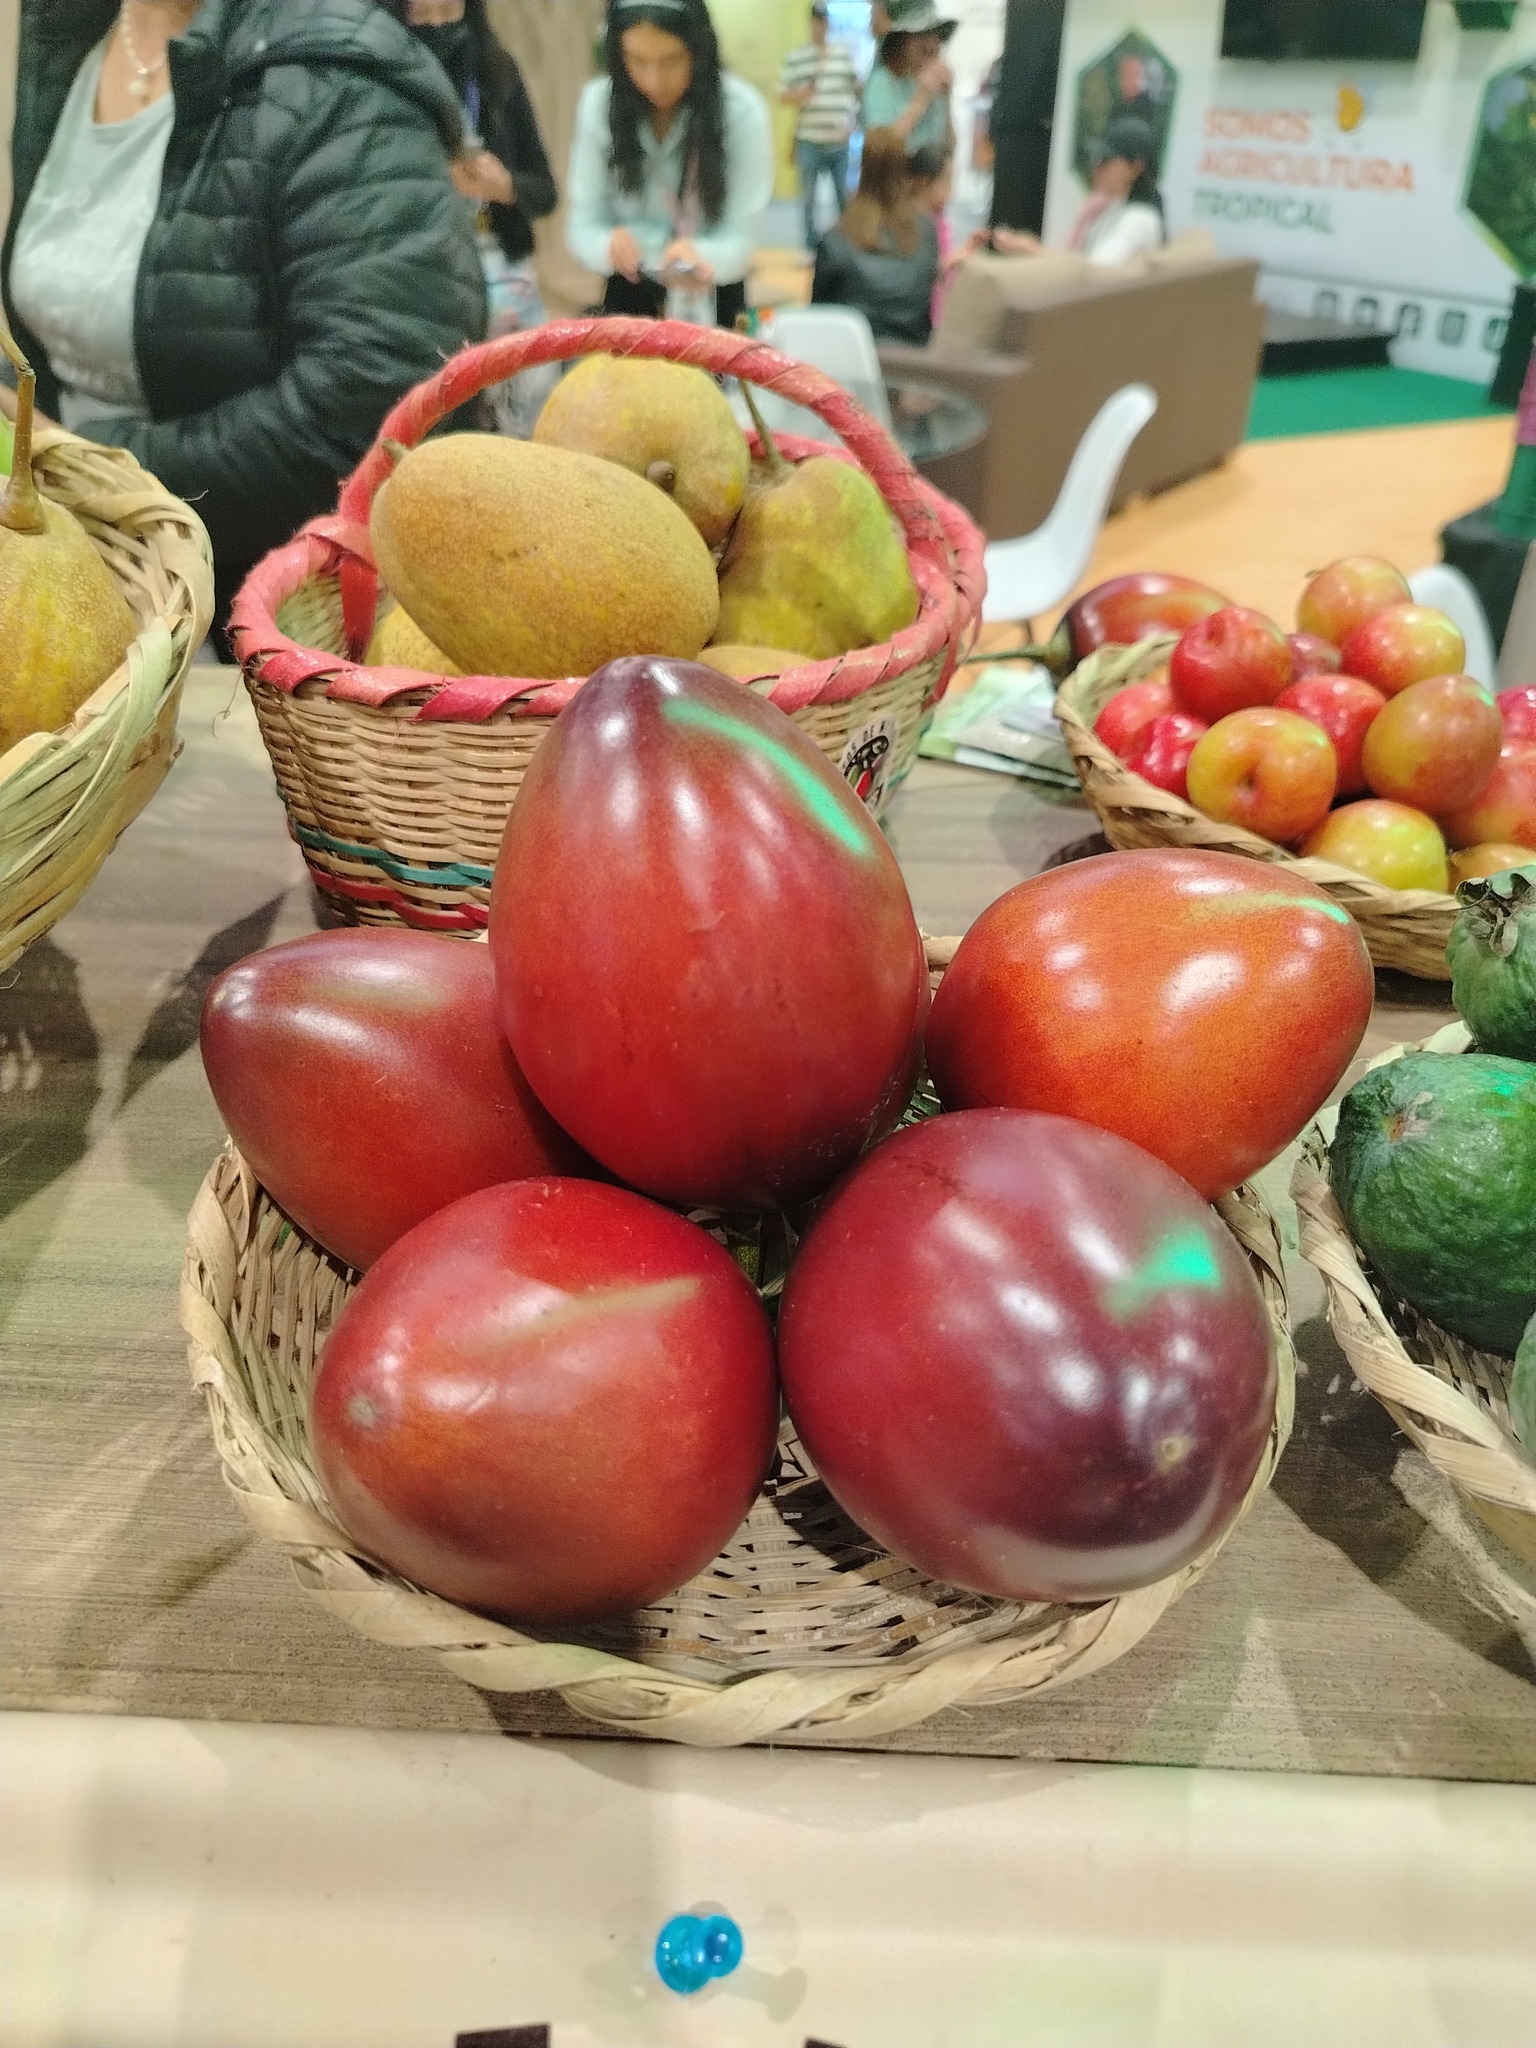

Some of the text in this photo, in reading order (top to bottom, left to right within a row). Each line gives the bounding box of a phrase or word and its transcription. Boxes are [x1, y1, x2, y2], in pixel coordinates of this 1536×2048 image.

[1205, 107, 1309, 143] SOMOS
[1198, 150, 1415, 192] AGRICULTURA
[1193, 187, 1332, 234] TROPICAL
